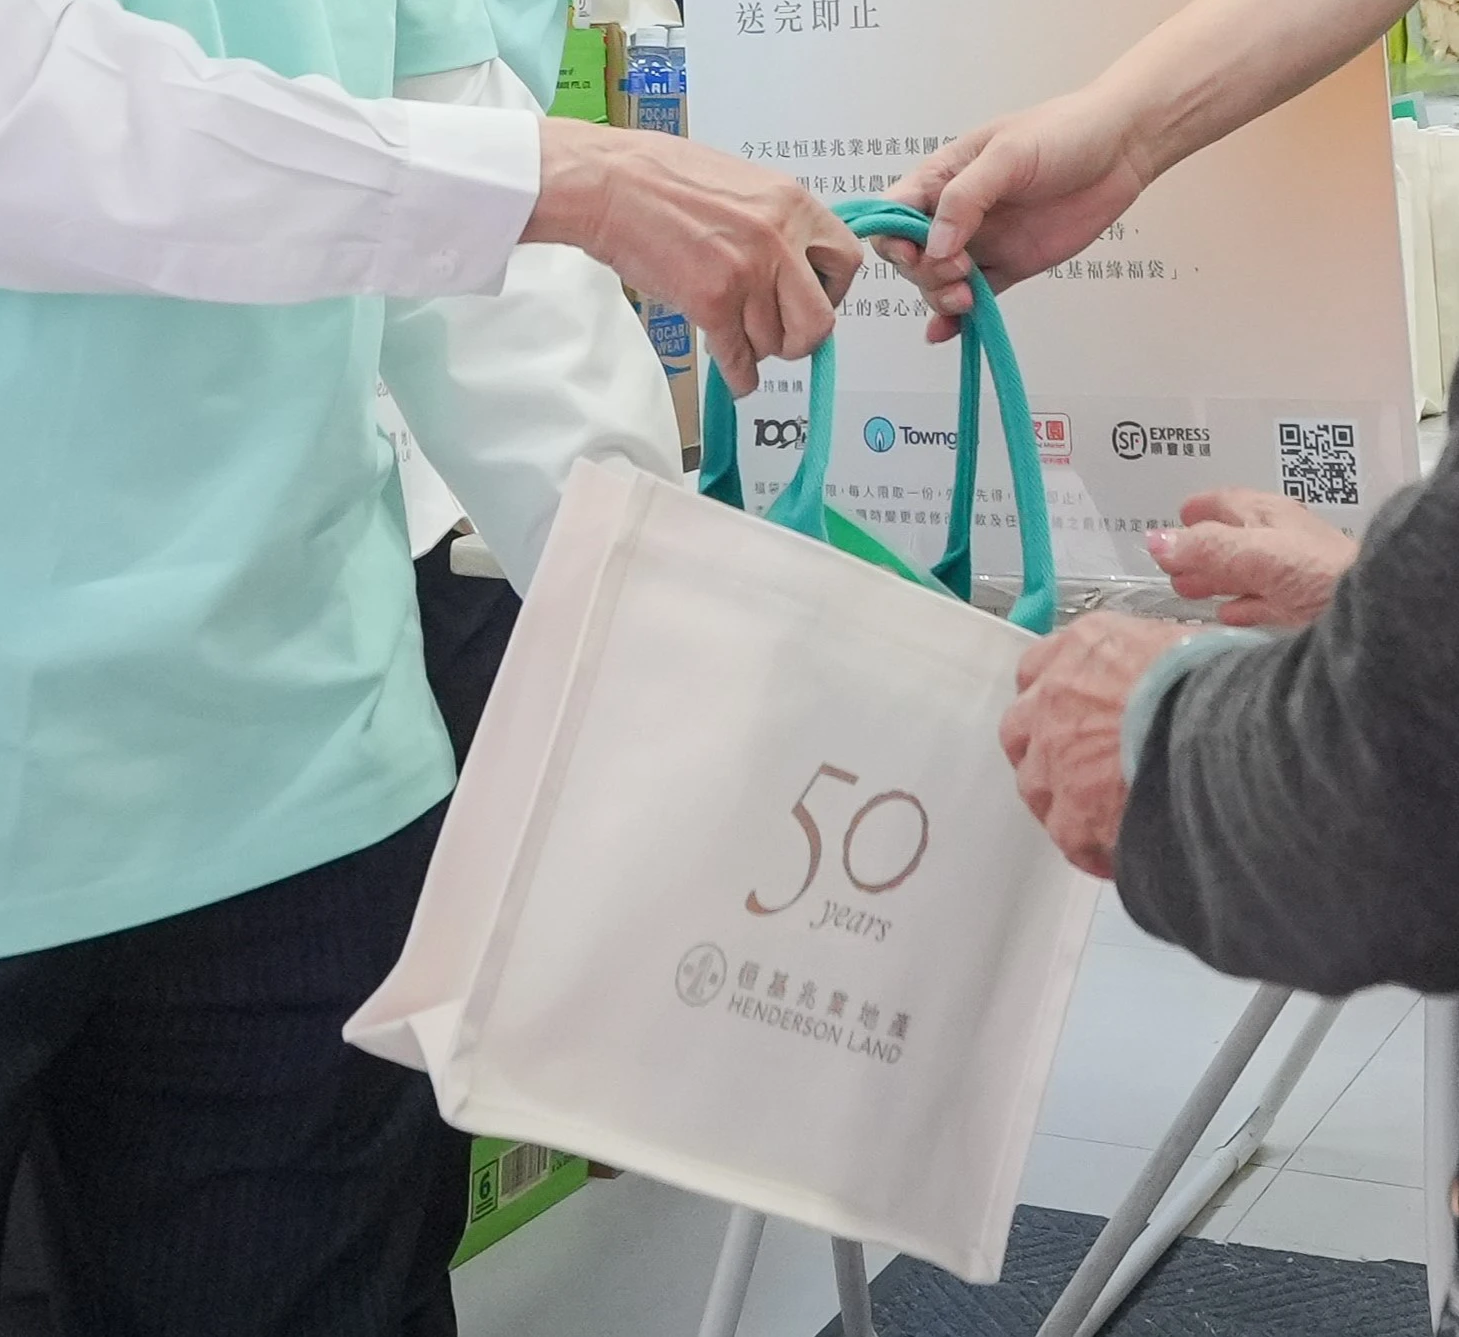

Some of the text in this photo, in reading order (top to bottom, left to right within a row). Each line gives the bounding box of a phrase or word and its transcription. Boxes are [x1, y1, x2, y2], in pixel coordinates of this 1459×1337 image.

[655, 338, 686, 354] WEAT
[756, 379, 803, 393] 持機構
[899, 425, 958, 450] Towng
[1119, 431, 1140, 450] SF
[1150, 427, 1210, 441] EXPRESS
[744, 760, 929, 917] 50
[810, 898, 893, 943] years
[737, 959, 912, 1041] 恒基兆業地產
[728, 991, 903, 1065] HENDERSON LAND
